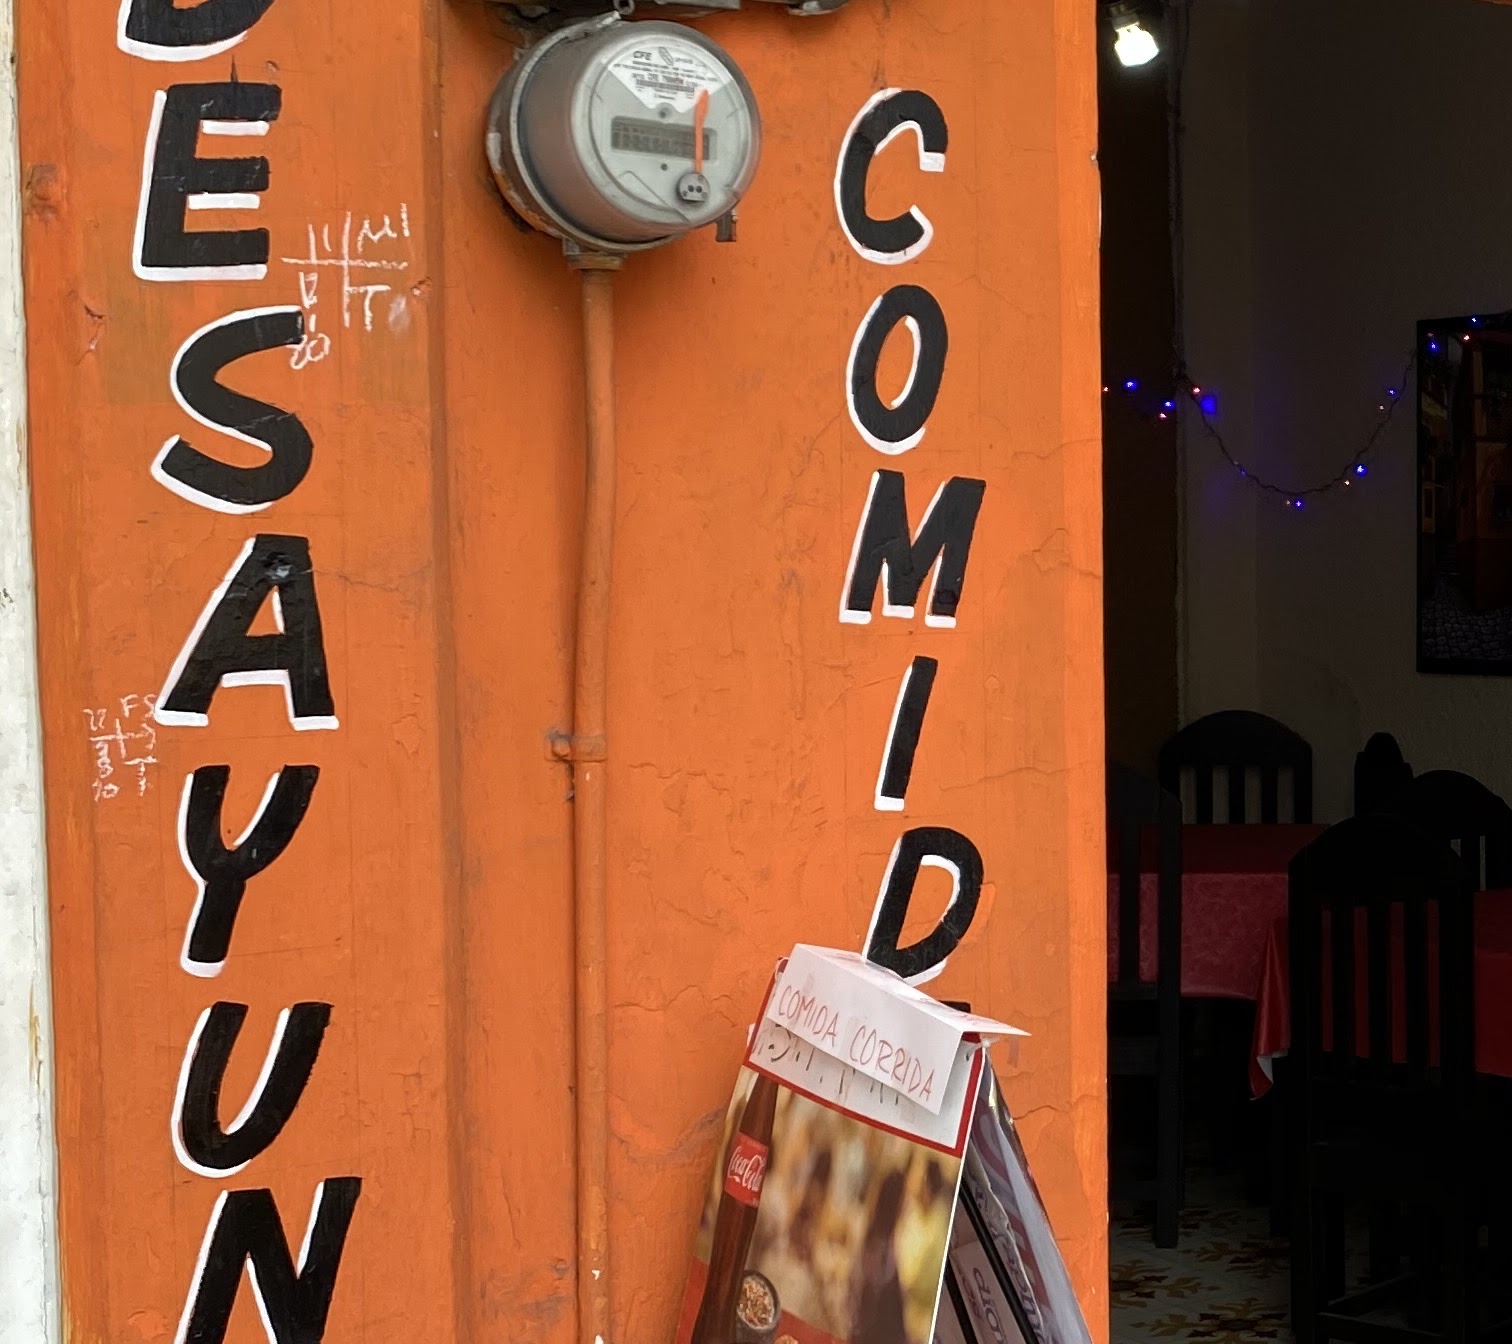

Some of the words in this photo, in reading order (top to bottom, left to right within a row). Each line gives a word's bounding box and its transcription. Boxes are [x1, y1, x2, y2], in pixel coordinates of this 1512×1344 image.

[834, 87, 986, 1013] COMID
[778, 984, 838, 1048] COMIDA
[849, 1025, 935, 1102] CORRIDA
